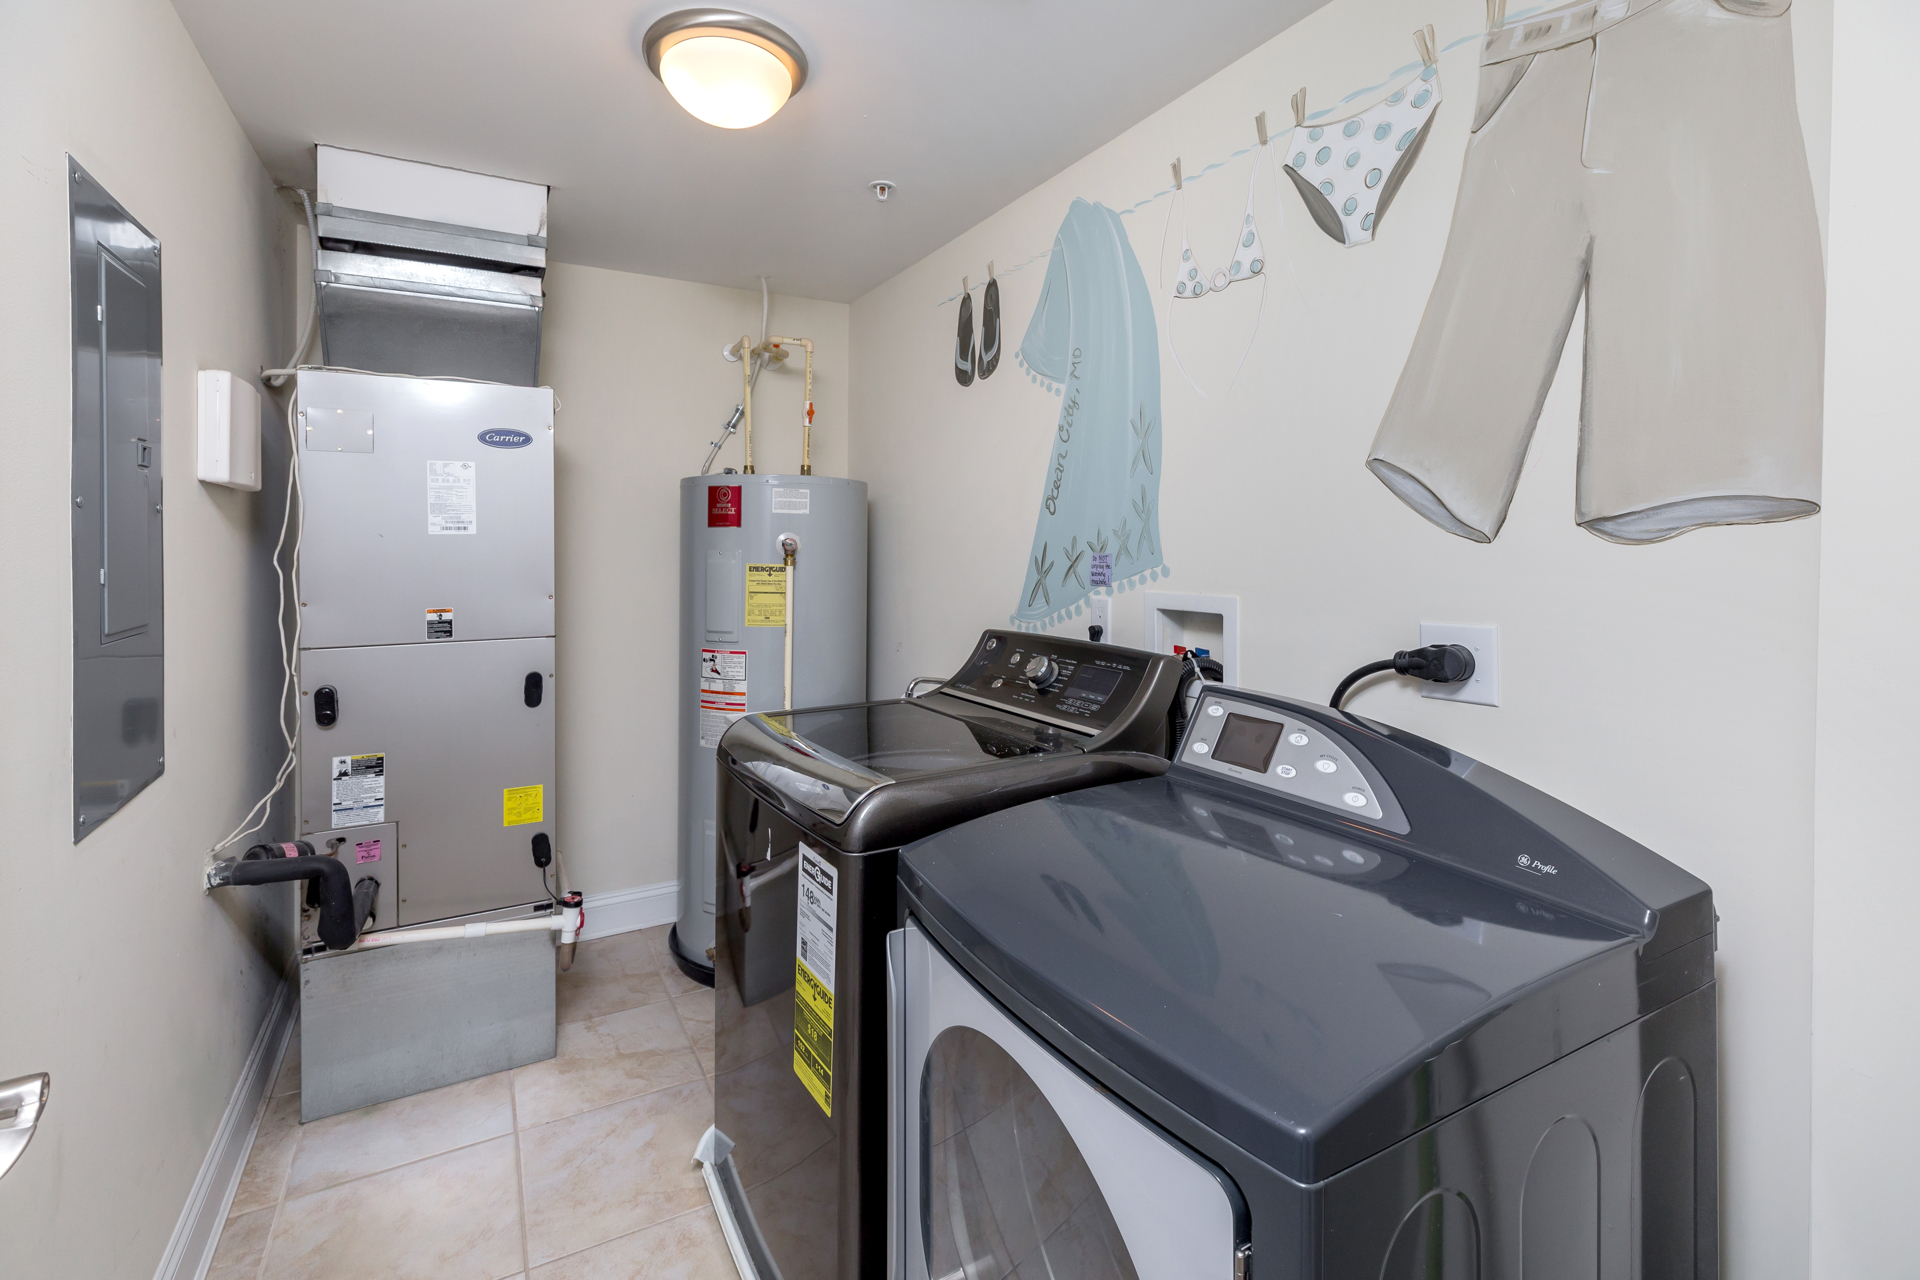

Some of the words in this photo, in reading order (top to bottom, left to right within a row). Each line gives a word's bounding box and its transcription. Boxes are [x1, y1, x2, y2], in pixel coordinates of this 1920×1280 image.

[485, 432, 526, 443] Carrier
[1045, 450, 1068, 516] Ocean
[1069, 347, 1083, 381] MD
[1531, 860, 1558, 874] Profile
[801, 883, 814, 905] 148
